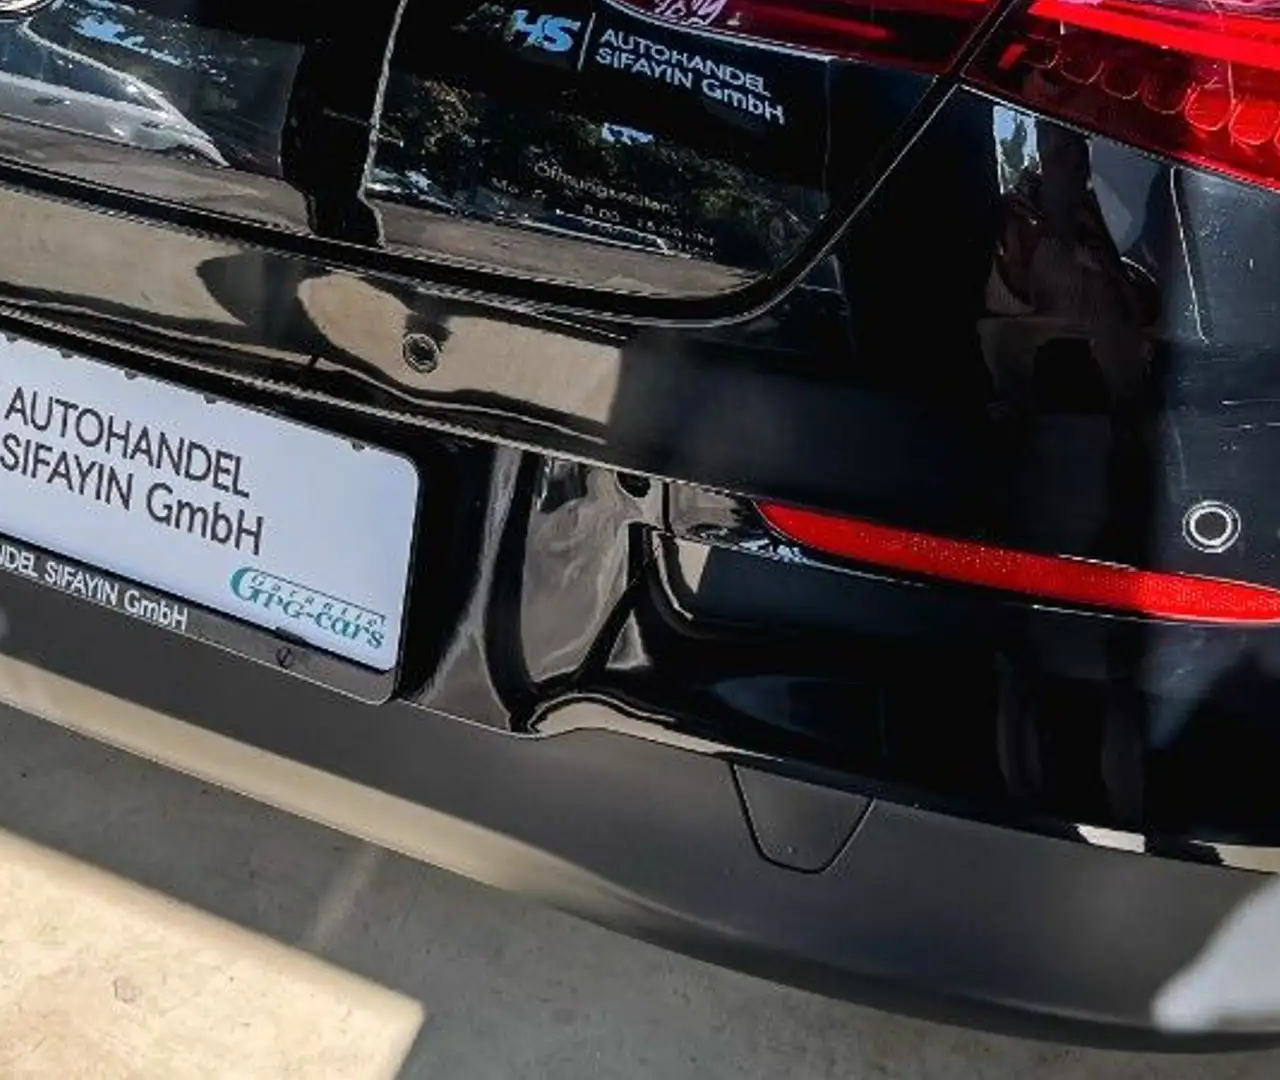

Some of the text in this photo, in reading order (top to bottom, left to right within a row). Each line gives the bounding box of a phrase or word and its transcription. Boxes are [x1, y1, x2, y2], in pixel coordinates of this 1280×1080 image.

[595, 47, 786, 126] SIFAYIN GmbH
[599, 27, 772, 98] AUTOHANDEL
[4, 386, 250, 498] AUTOHANDEL
[0, 434, 264, 557] SIFAYIN GmbH
[44, 561, 119, 606] SIFAYIN
[124, 590, 189, 632] GmbH
